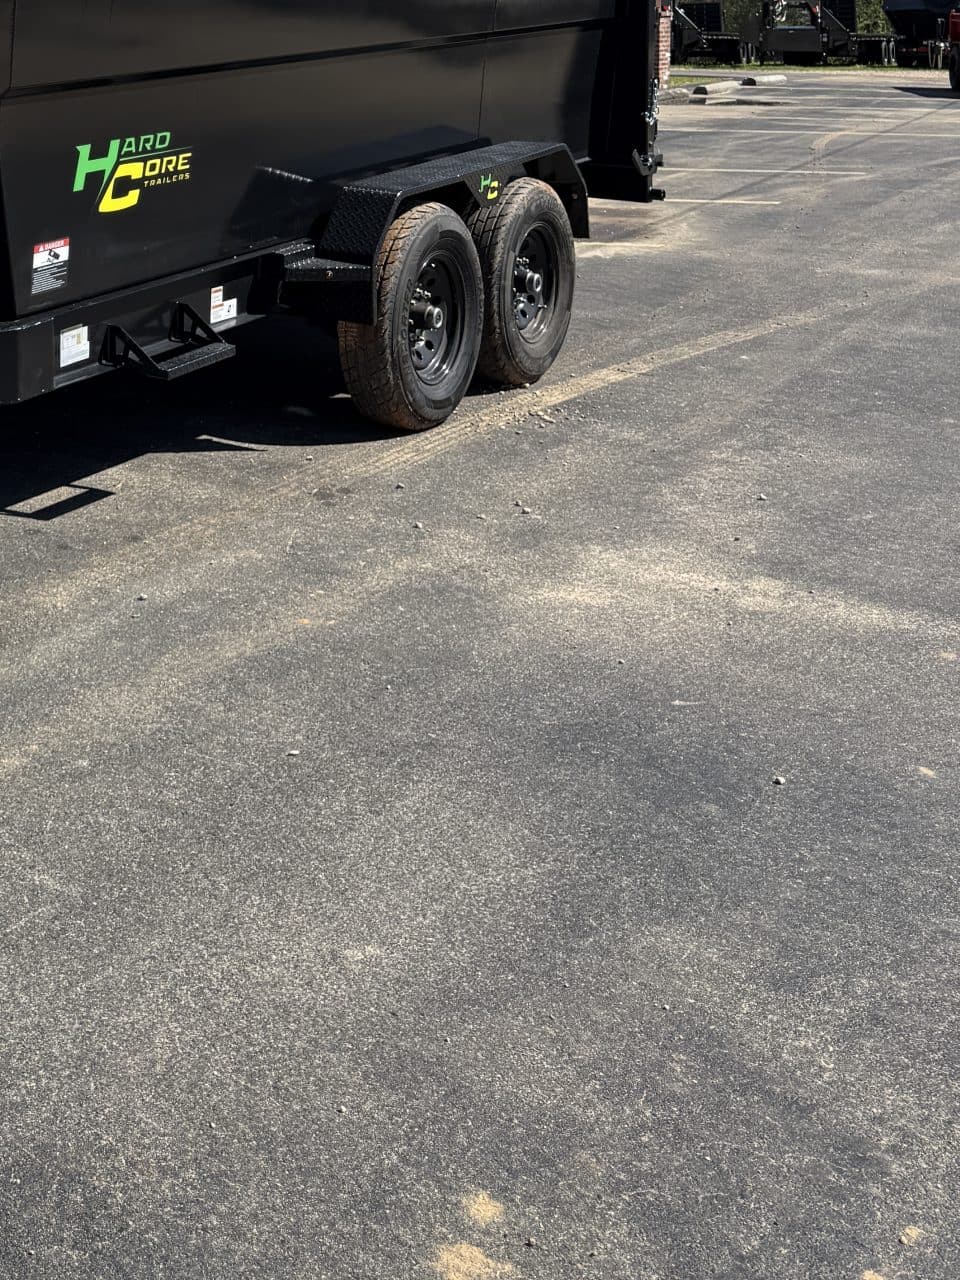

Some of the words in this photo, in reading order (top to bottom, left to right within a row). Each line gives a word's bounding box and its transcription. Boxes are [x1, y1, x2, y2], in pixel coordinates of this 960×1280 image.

[73, 131, 171, 202] HARD
[99, 152, 192, 213] CORE
[143, 172, 191, 188] TRAILERS
